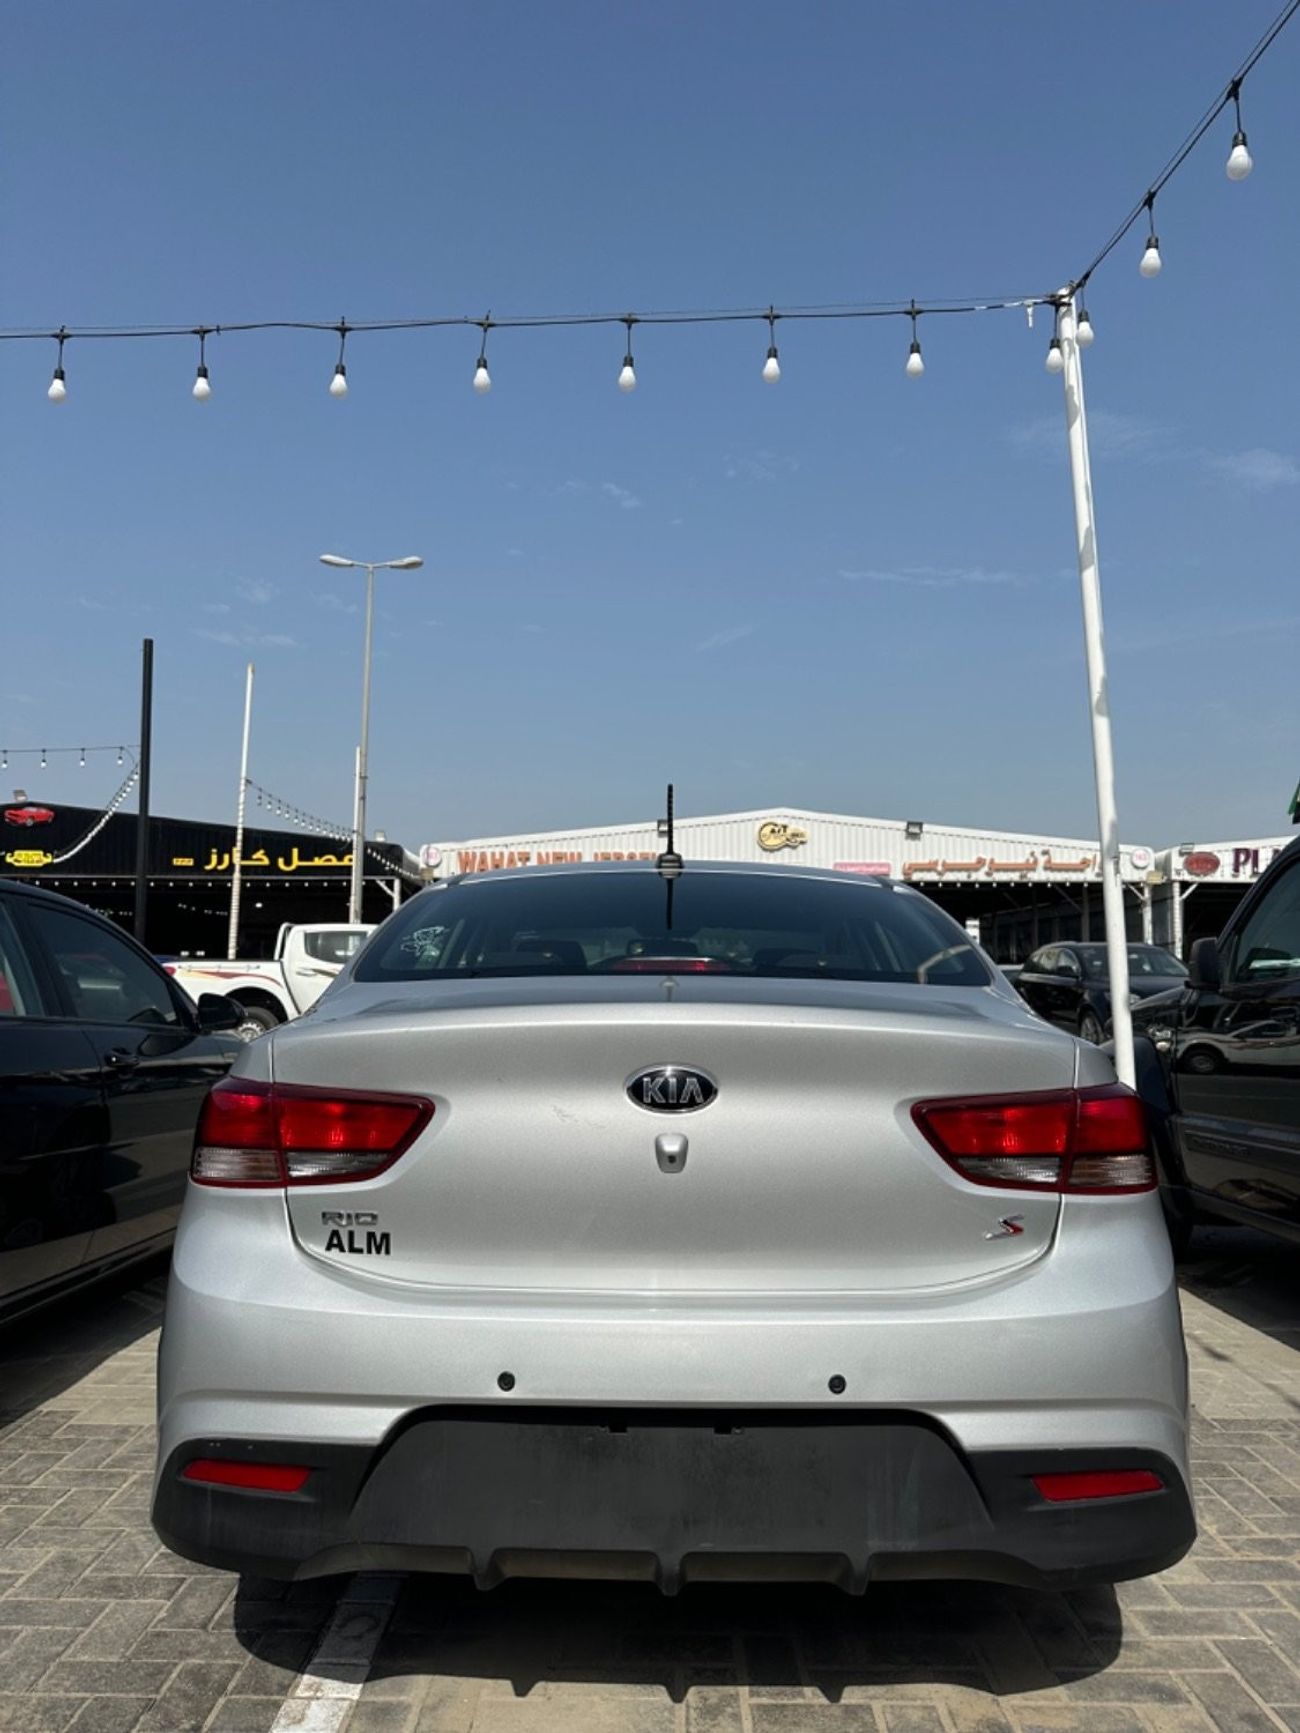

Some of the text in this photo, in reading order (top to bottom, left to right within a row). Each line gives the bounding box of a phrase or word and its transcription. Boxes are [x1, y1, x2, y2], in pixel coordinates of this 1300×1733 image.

[457, 851, 531, 873] WAHAT
[642, 1077, 705, 1104] KIA
[321, 1210, 379, 1227] RIO
[324, 1229, 392, 1256] ALM
